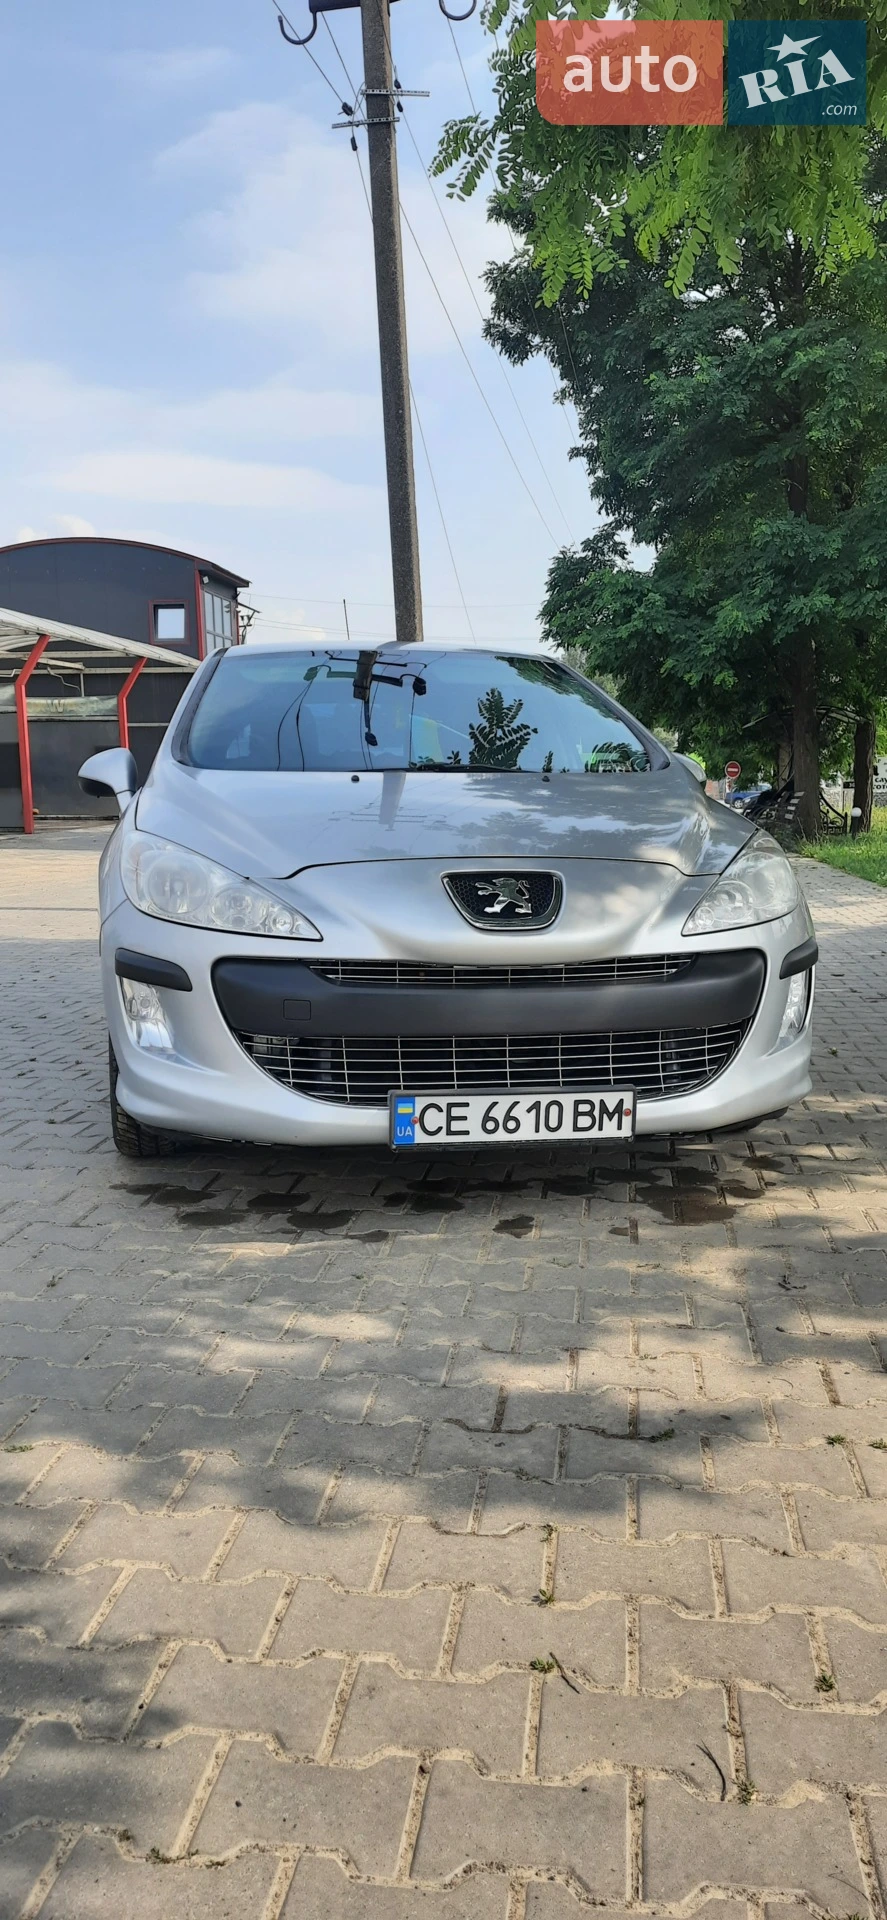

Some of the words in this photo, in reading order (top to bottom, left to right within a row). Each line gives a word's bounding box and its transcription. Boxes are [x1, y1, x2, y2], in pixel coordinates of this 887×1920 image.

[419, 1102, 470, 1136] CE
[481, 1100, 563, 1134] 6610
[573, 1098, 624, 1132] BM
[397, 1126, 413, 1136] UA
